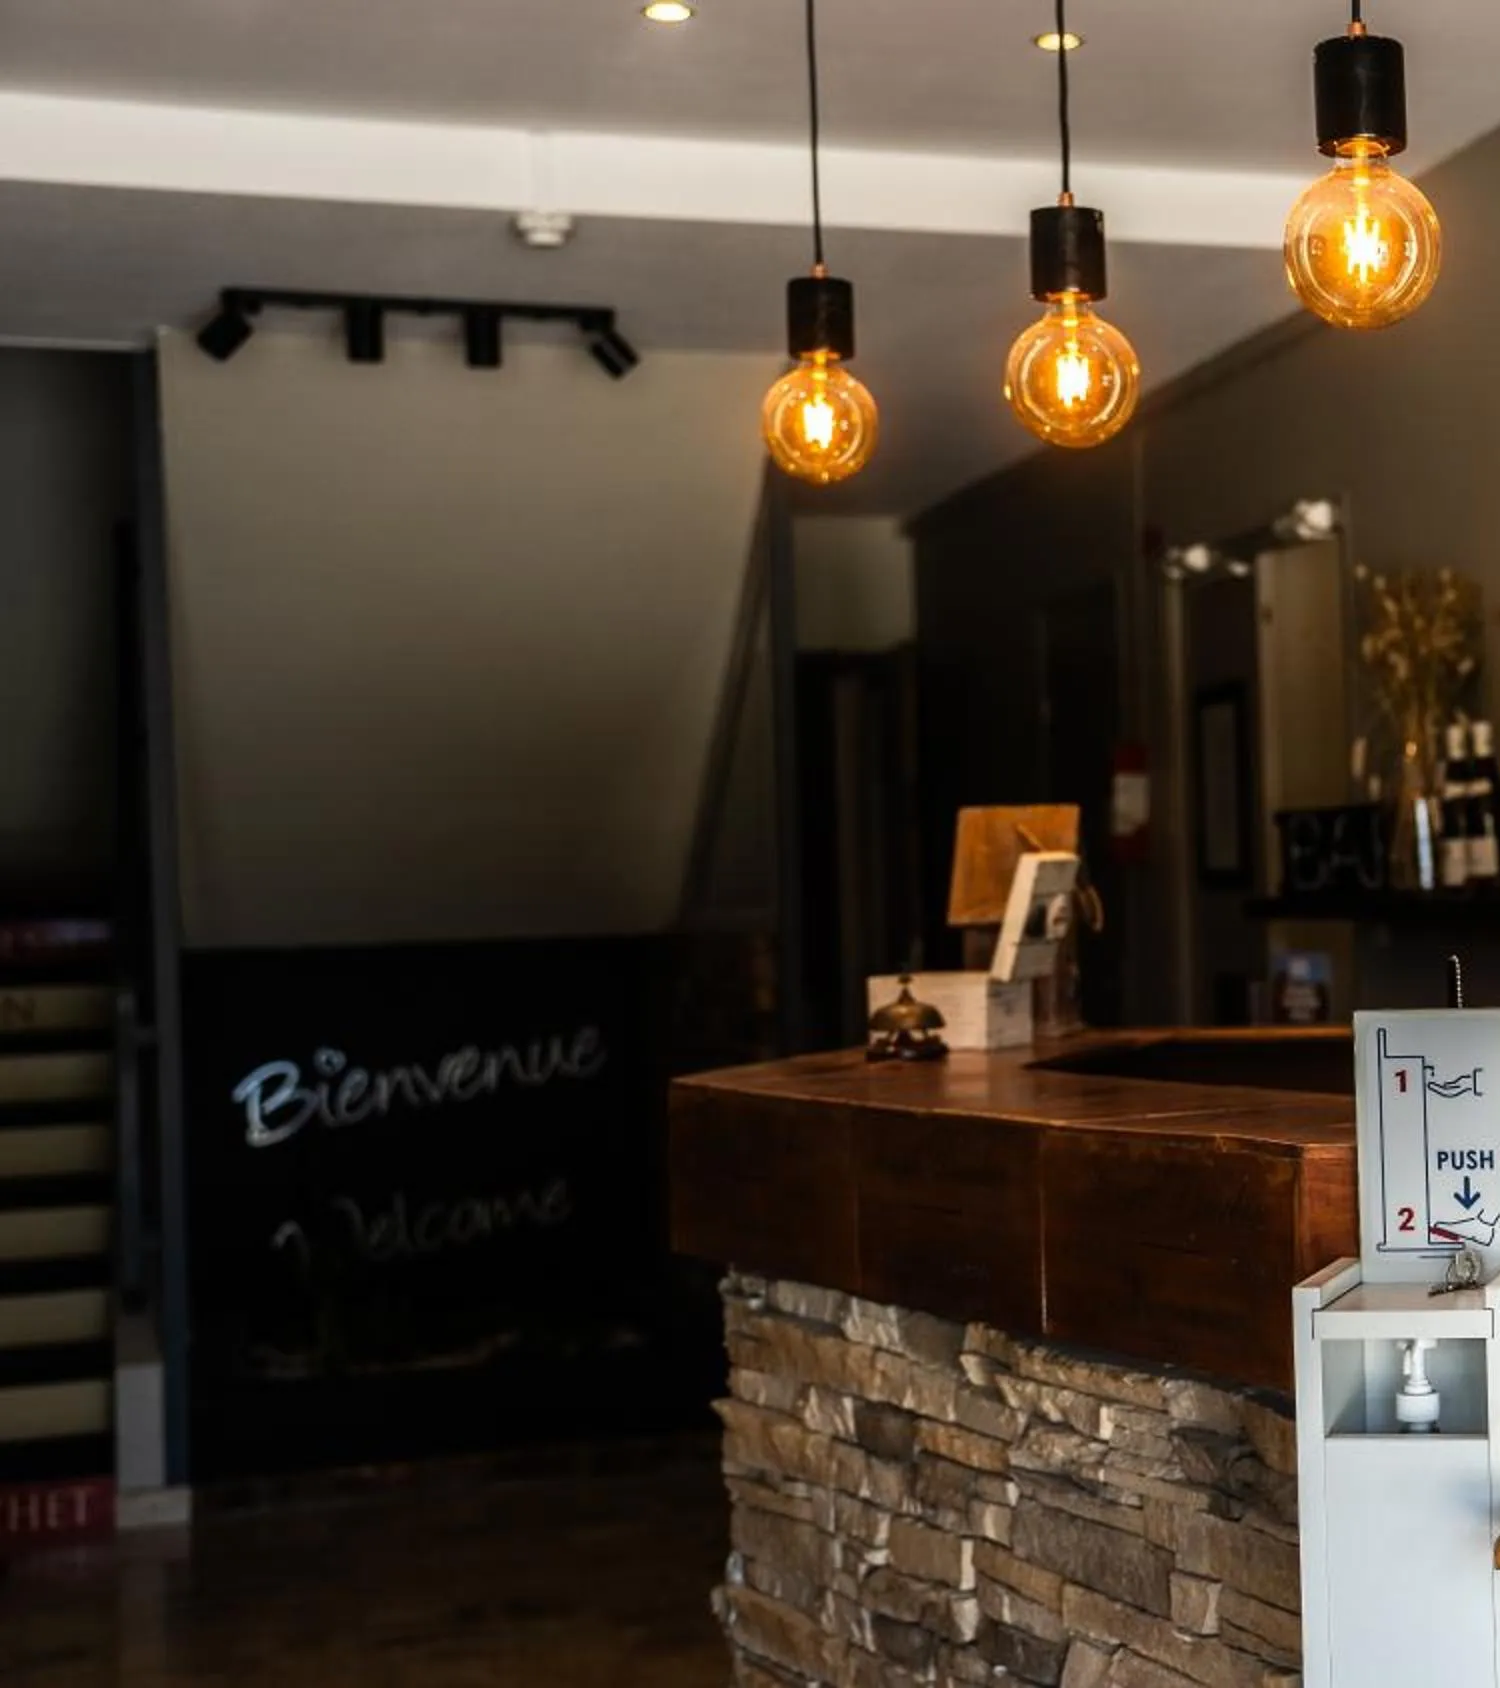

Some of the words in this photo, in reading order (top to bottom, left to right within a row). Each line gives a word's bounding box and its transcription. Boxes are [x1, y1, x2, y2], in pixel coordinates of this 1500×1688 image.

[230, 1022, 608, 1149] Bienvenue
[1395, 1069, 1408, 1093] 1
[1437, 1150, 1494, 1170] PUSH
[268, 1177, 575, 1268] Welcome
[1397, 1208, 1415, 1231] 2
